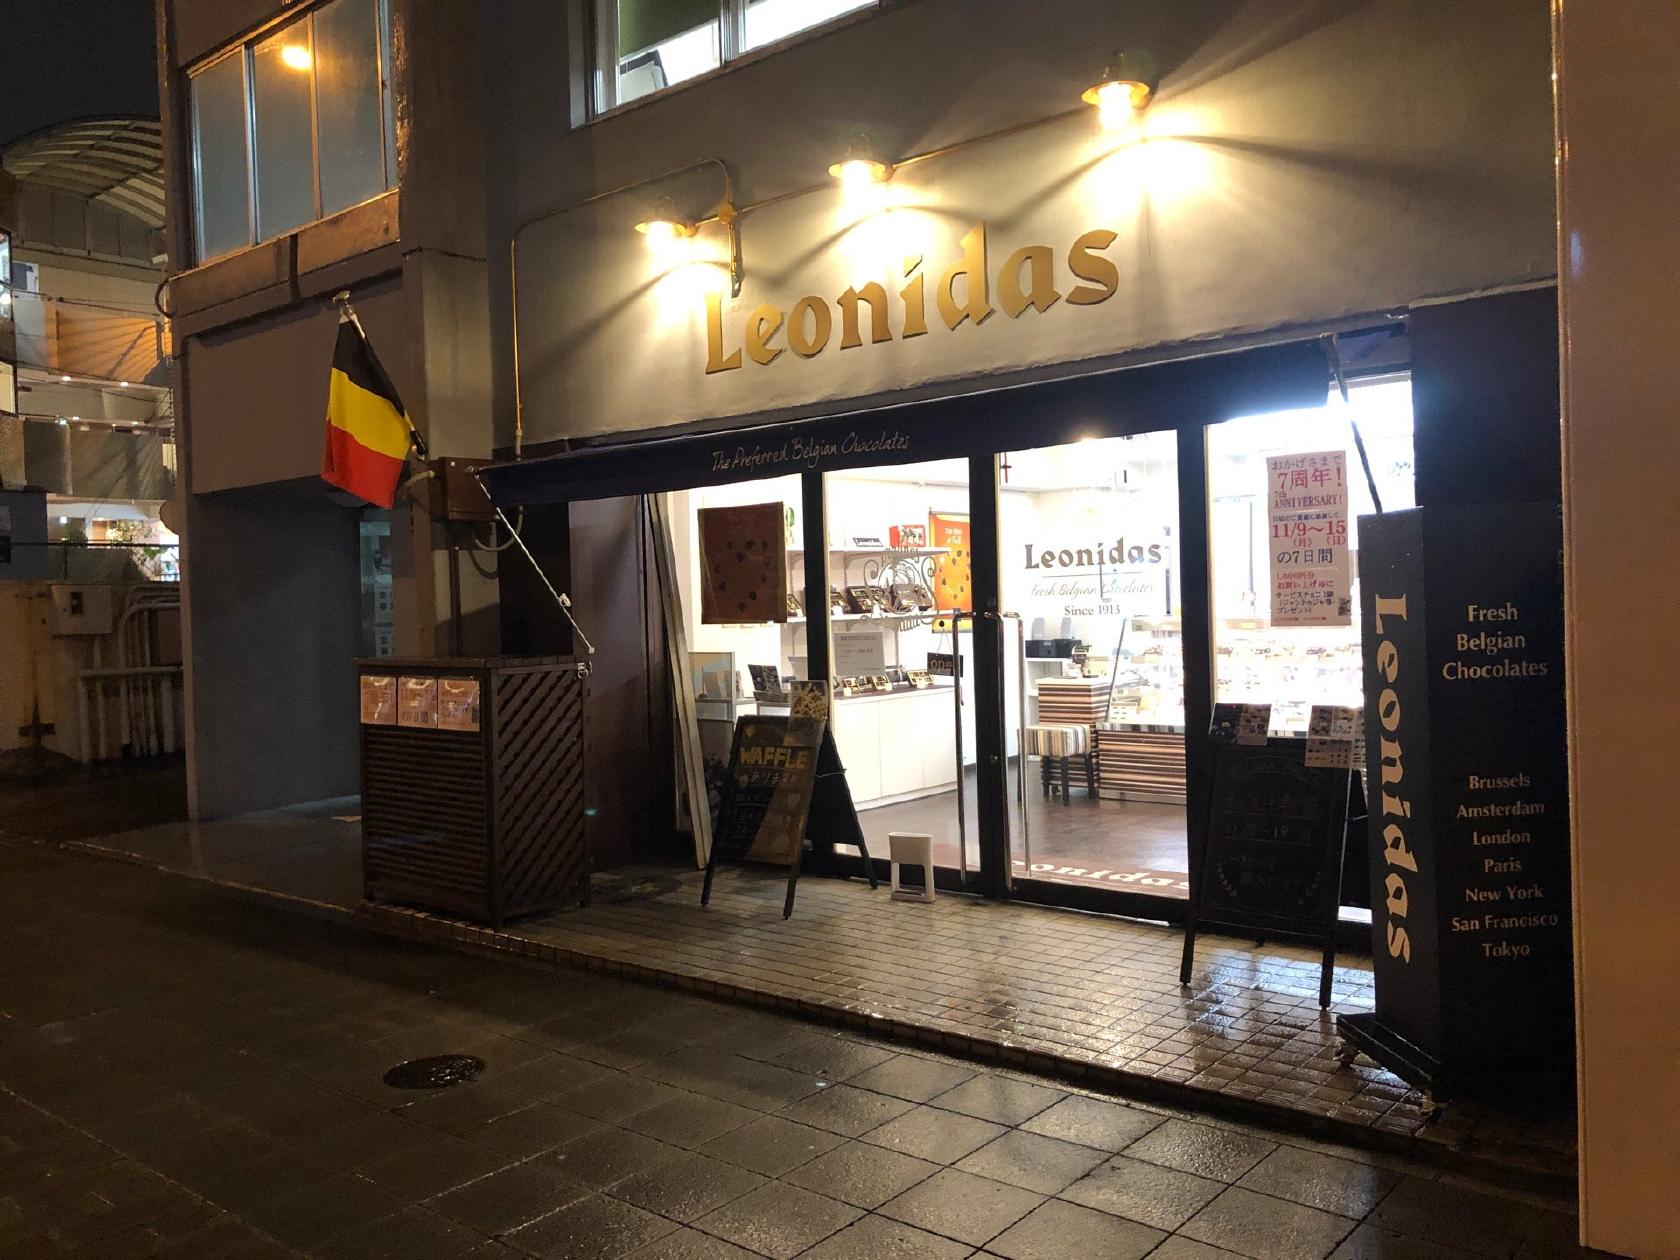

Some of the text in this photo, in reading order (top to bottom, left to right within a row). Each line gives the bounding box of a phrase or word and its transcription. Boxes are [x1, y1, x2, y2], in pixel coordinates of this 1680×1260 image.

[704, 219, 1120, 375] Leonidas
[712, 430, 911, 473] The Preferred Belgian Chocolates
[1271, 454, 1342, 472] おかげさまで
[1023, 536, 1162, 570] Leonidas
[1277, 548, 1334, 565] の7日間
[1063, 604, 1121, 617] Since 1913
[1467, 602, 1519, 622] Fresh
[1456, 631, 1526, 656] Belgian
[1442, 659, 1549, 681] Chocolates
[740, 746, 810, 770] WAFFLE
[1375, 592, 1419, 964] Leonidas
[1468, 772, 1532, 791] Brussels
[1456, 801, 1546, 820] Amsterdam
[1472, 830, 1532, 847] London
[1483, 857, 1523, 874] Paris
[1465, 884, 1544, 903] New York
[1451, 913, 1559, 933] San Francisco
[1481, 942, 1531, 961] Tokyo
